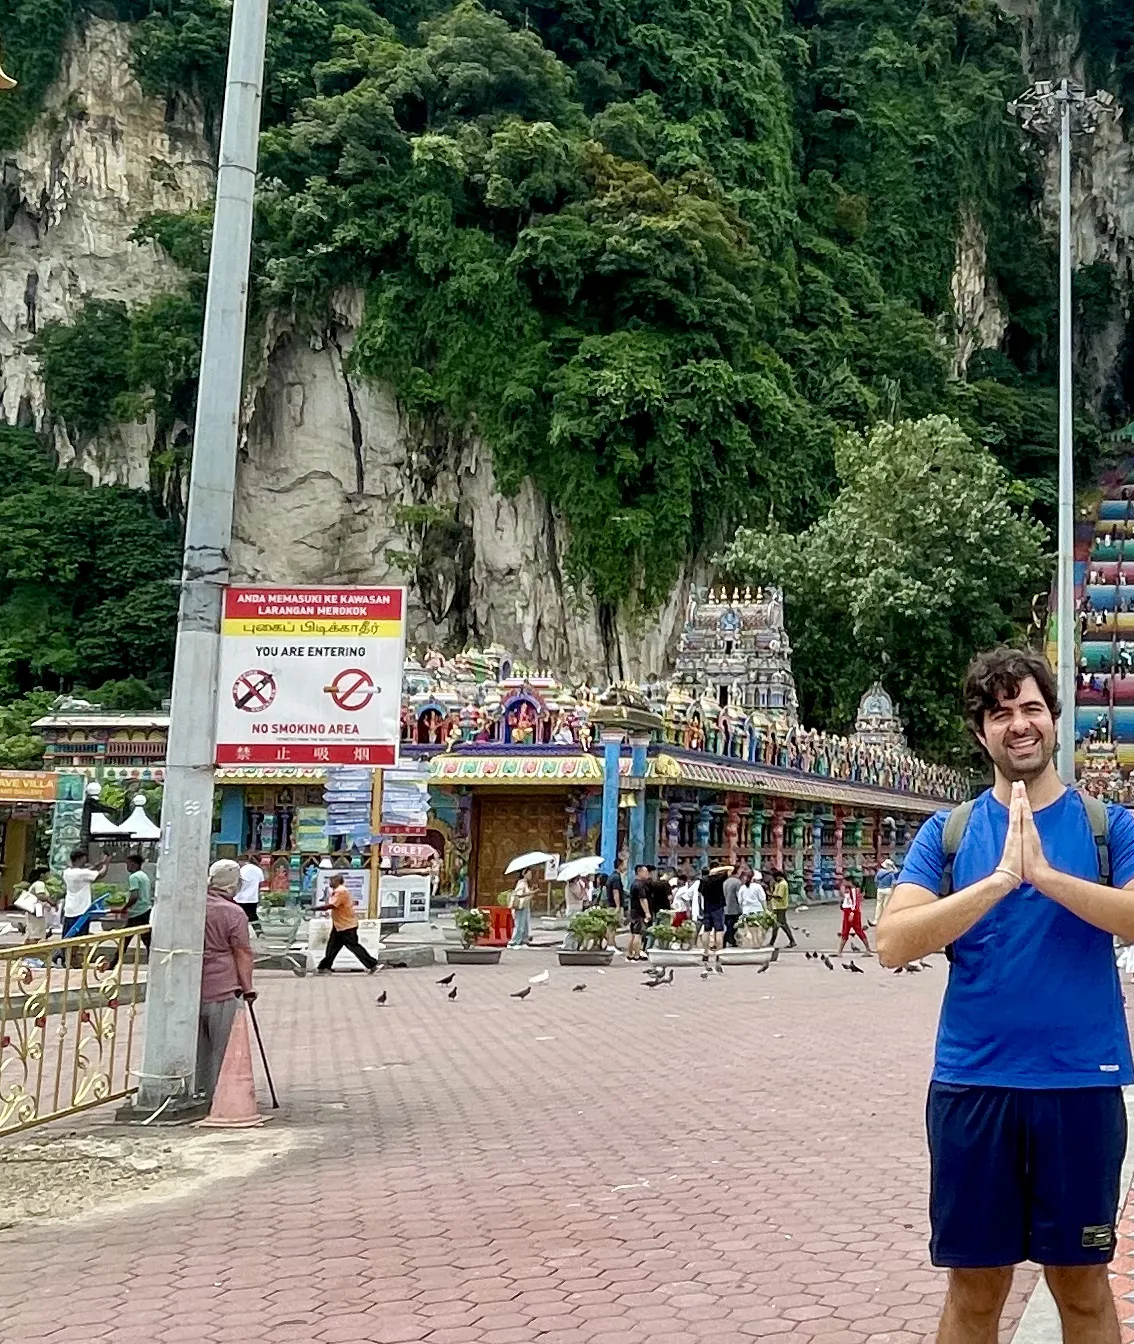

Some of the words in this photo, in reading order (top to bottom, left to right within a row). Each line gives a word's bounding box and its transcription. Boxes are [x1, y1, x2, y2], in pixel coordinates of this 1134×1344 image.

[237, 594, 266, 603] ANDA
[268, 594, 322, 604] MEMASUKI
[324, 595, 338, 604] KE
[340, 595, 390, 604] KAWASAN
[258, 606, 314, 615] LARANGAN
[317, 607, 367, 615] MEROKOK
[243, 621, 295, 634] புகைப்
[301, 621, 379, 636] பிடிக்காதீர்
[256, 646, 278, 656] YOU
[281, 647, 304, 656] ARE
[308, 647, 366, 657] ENTERING
[252, 724, 268, 734] NO
[271, 724, 325, 734] SMOKING
[328, 725, 359, 735] AREA
[22, 779, 54, 789] VILLA
[388, 845, 423, 855] TOILET
